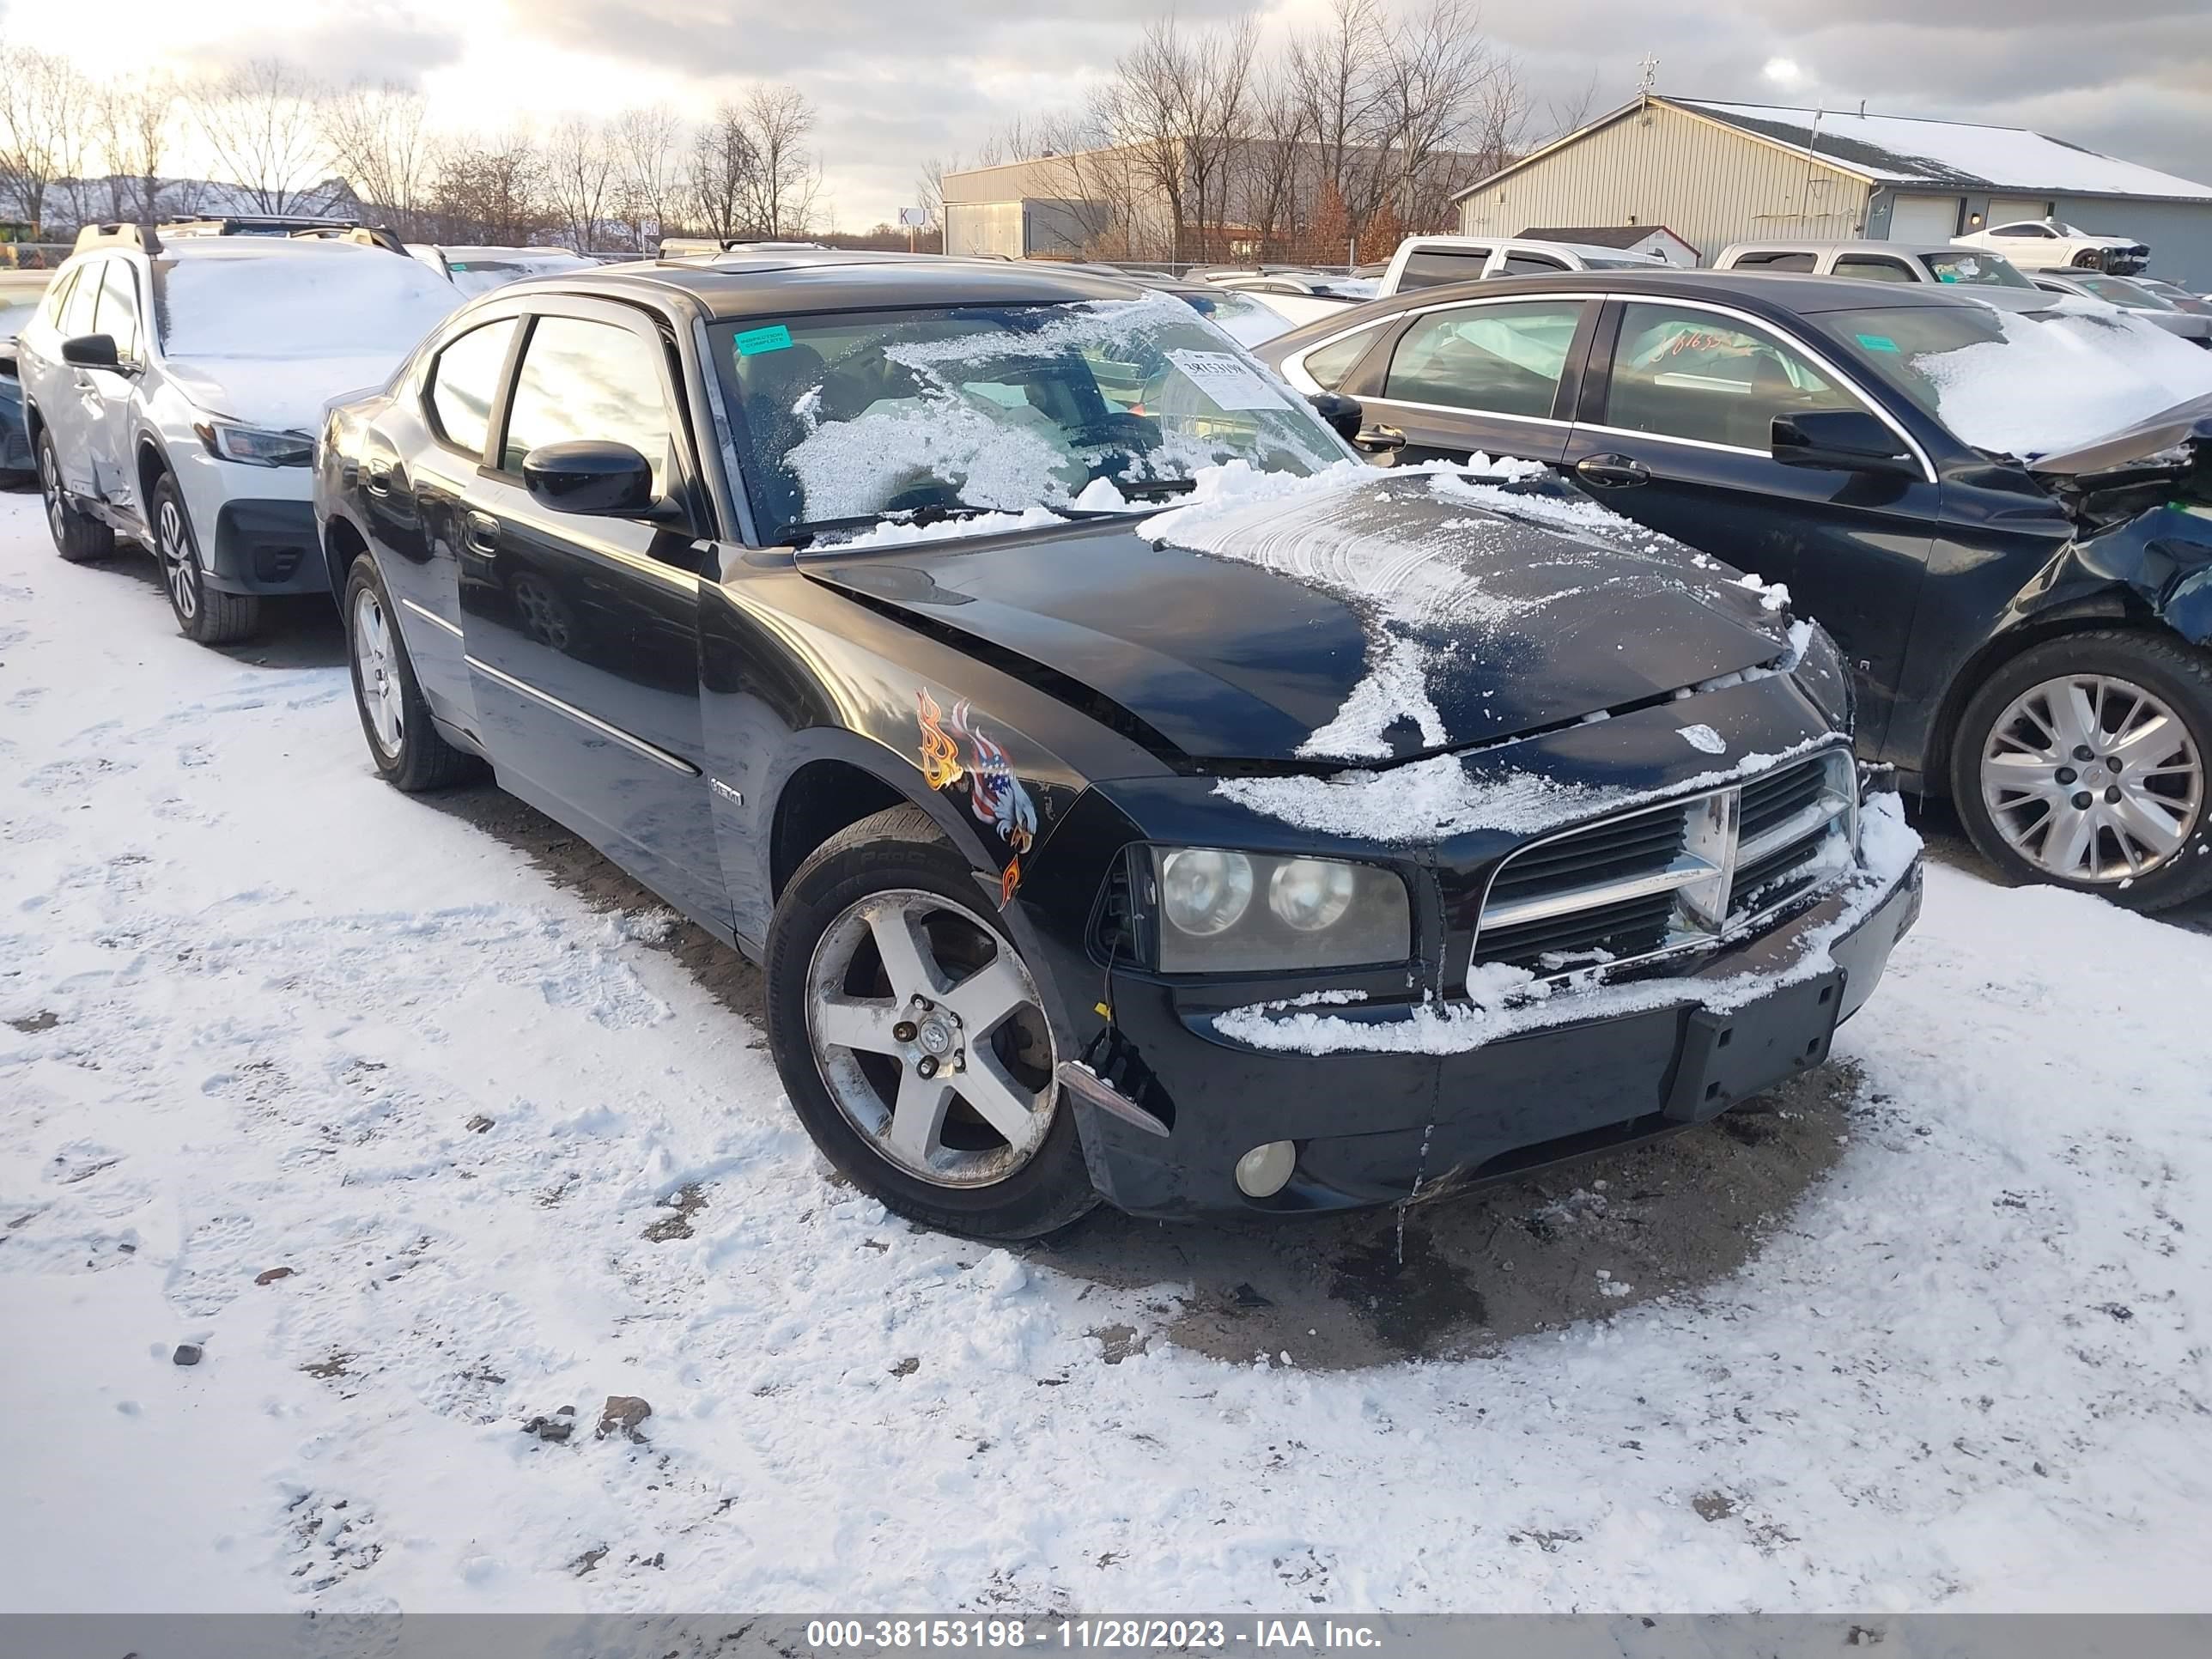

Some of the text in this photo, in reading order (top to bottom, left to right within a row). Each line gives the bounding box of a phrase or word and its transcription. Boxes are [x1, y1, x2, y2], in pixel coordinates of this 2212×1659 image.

[900, 207, 926, 225] K J
[645, 222, 658, 235] 50
[740, 332, 784, 344] INSPECTION
[745, 337, 784, 349] COMPLETE
[1183, 362, 1248, 375] 38153198
